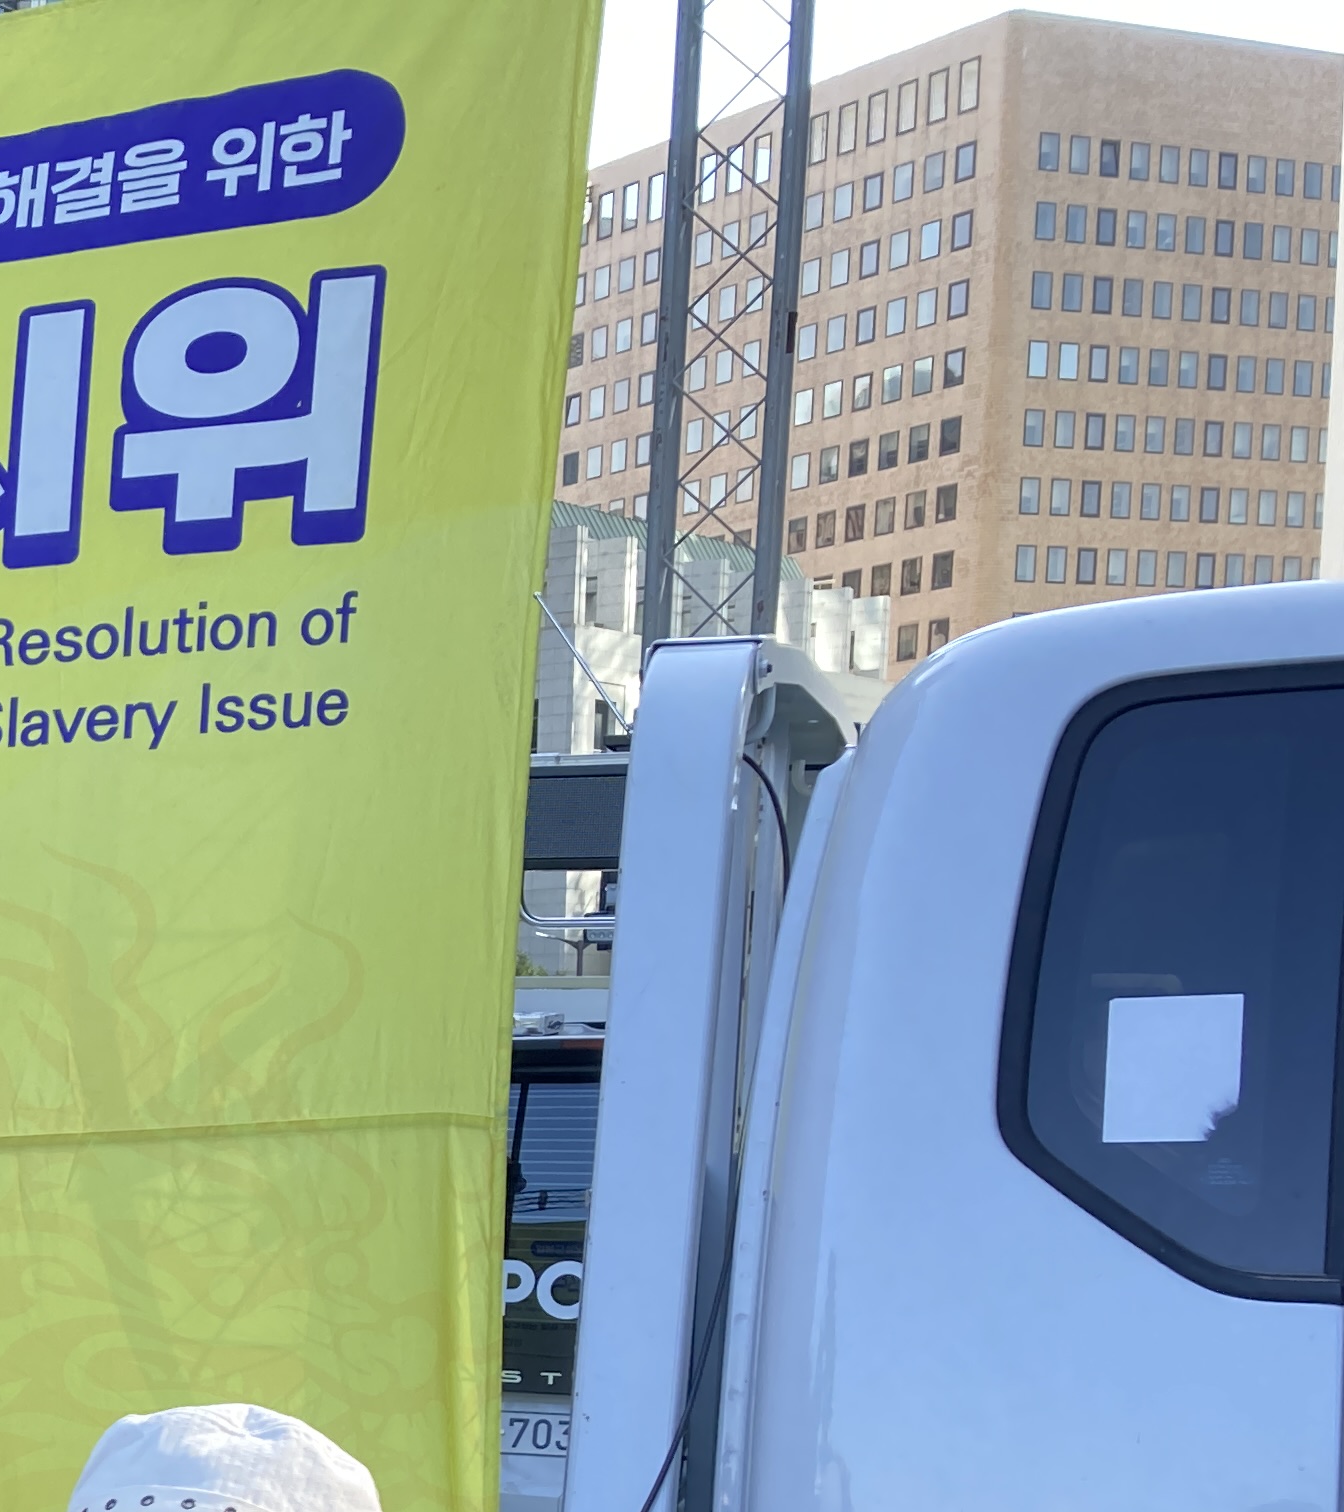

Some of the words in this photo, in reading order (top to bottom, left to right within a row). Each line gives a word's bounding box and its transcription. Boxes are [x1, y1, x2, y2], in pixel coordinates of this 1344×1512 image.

[206, 109, 353, 197] 위한
[301, 590, 359, 647] of
[199, 682, 350, 735] Issue
